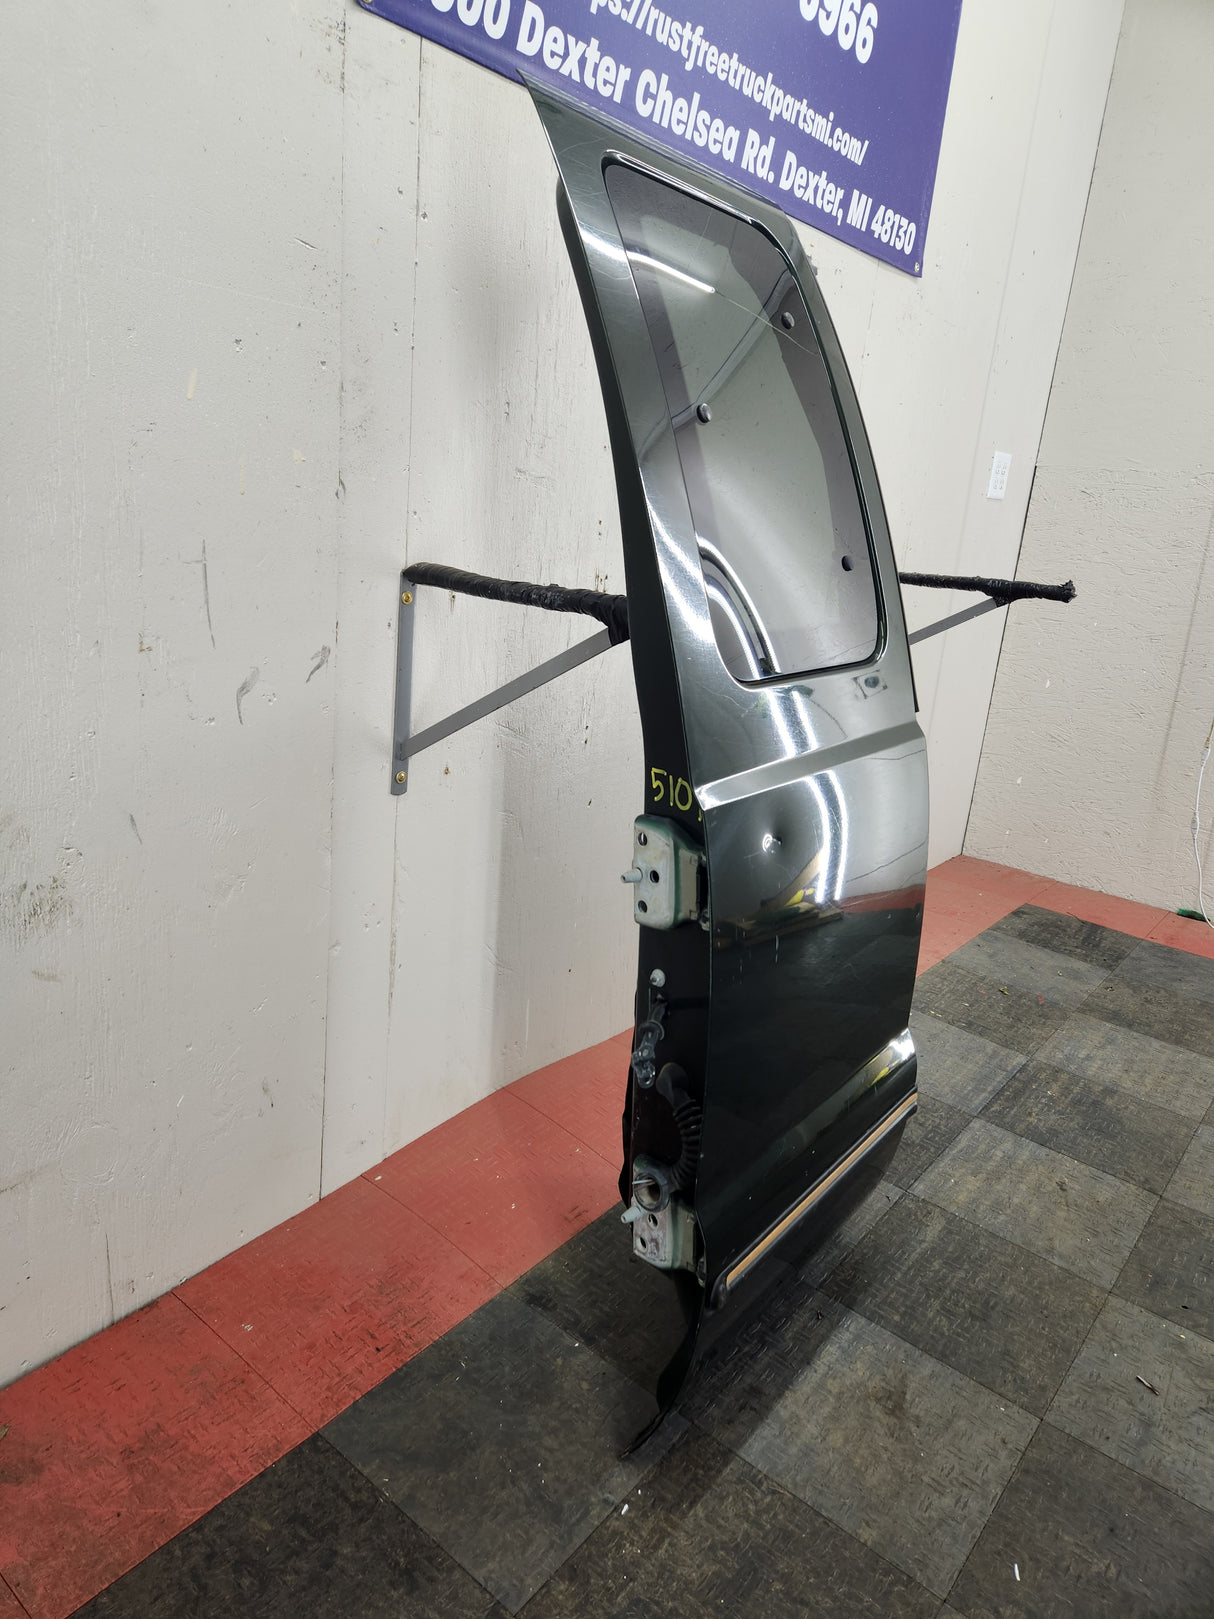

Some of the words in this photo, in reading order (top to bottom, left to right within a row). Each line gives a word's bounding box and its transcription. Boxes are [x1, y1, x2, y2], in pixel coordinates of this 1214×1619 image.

[516, 0, 631, 103] Dexter
[635, 69, 740, 163] Chelsea
[741, 128, 775, 183] Rd.
[779, 150, 845, 226] Dexter,
[847, 189, 873, 231] MI
[870, 205, 917, 255] 48130
[651, 767, 702, 822] 510
